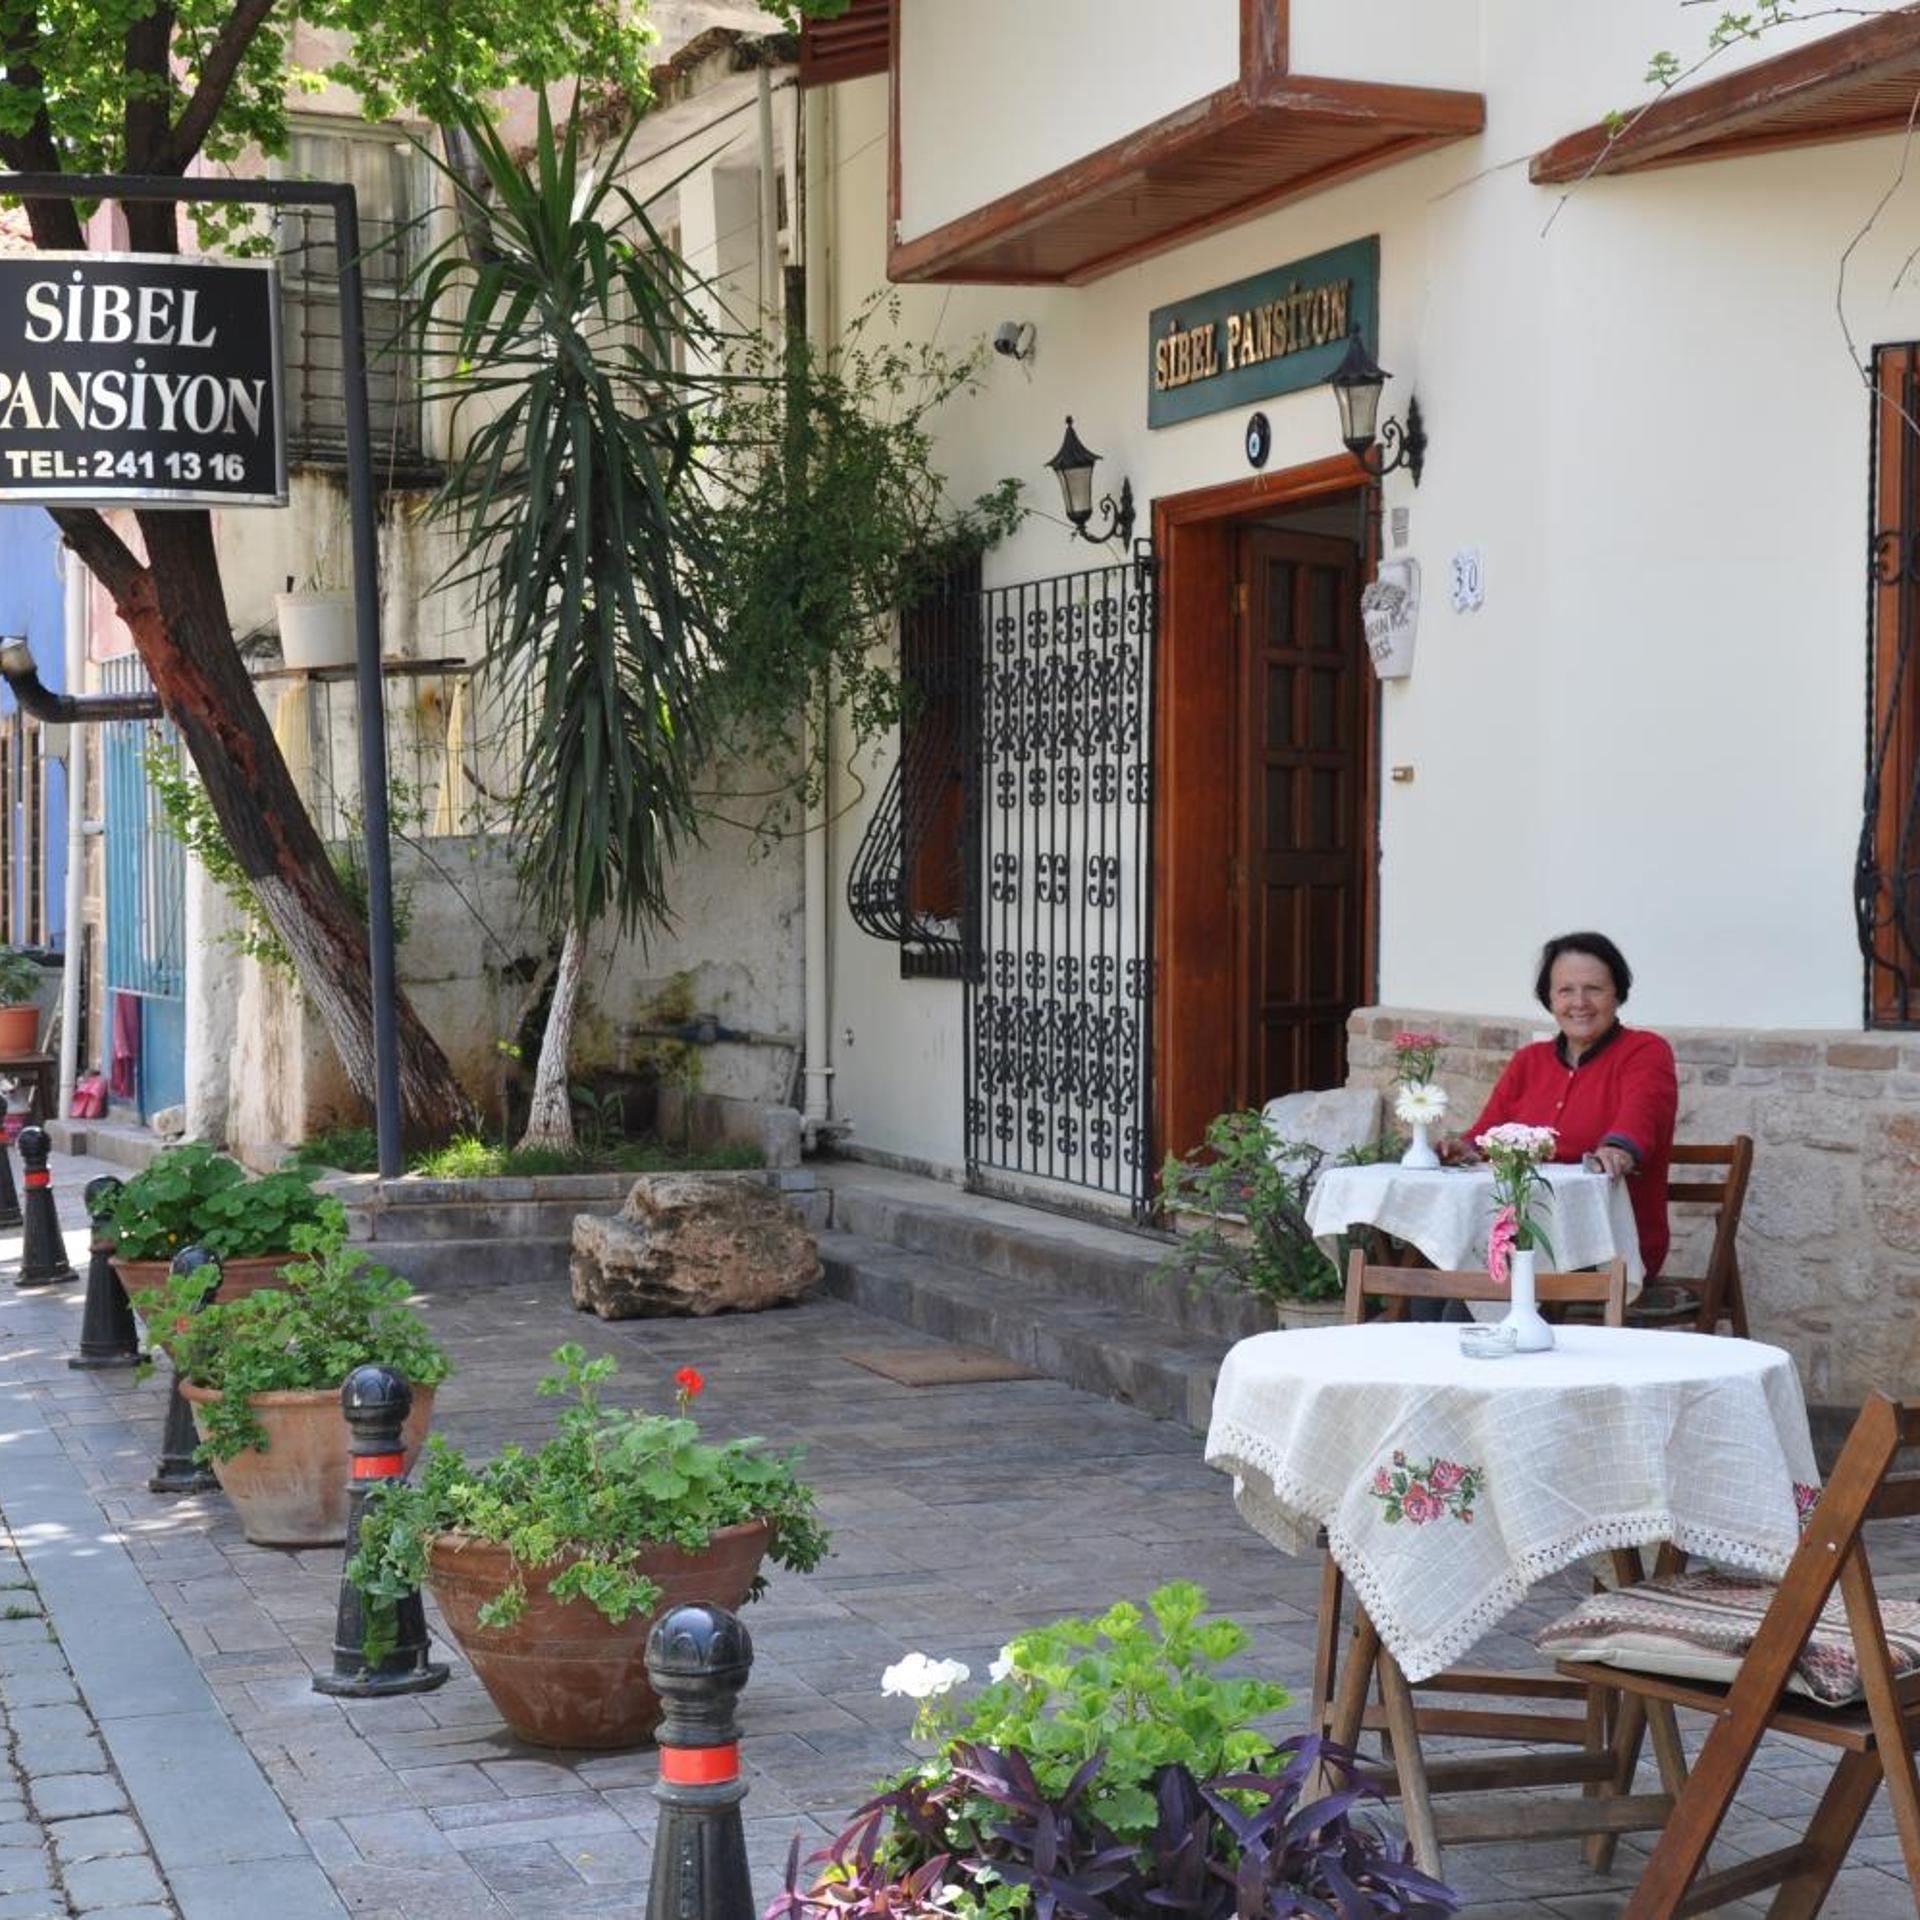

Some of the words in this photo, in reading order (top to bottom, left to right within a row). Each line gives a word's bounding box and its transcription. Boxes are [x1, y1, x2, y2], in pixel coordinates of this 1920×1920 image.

[25, 269, 217, 348] SİBEL
[1155, 320, 1219, 391] SİBEL
[1226, 280, 1353, 371] PANSİYON
[164, 451, 202, 481] 13
[208, 453, 245, 482] 16
